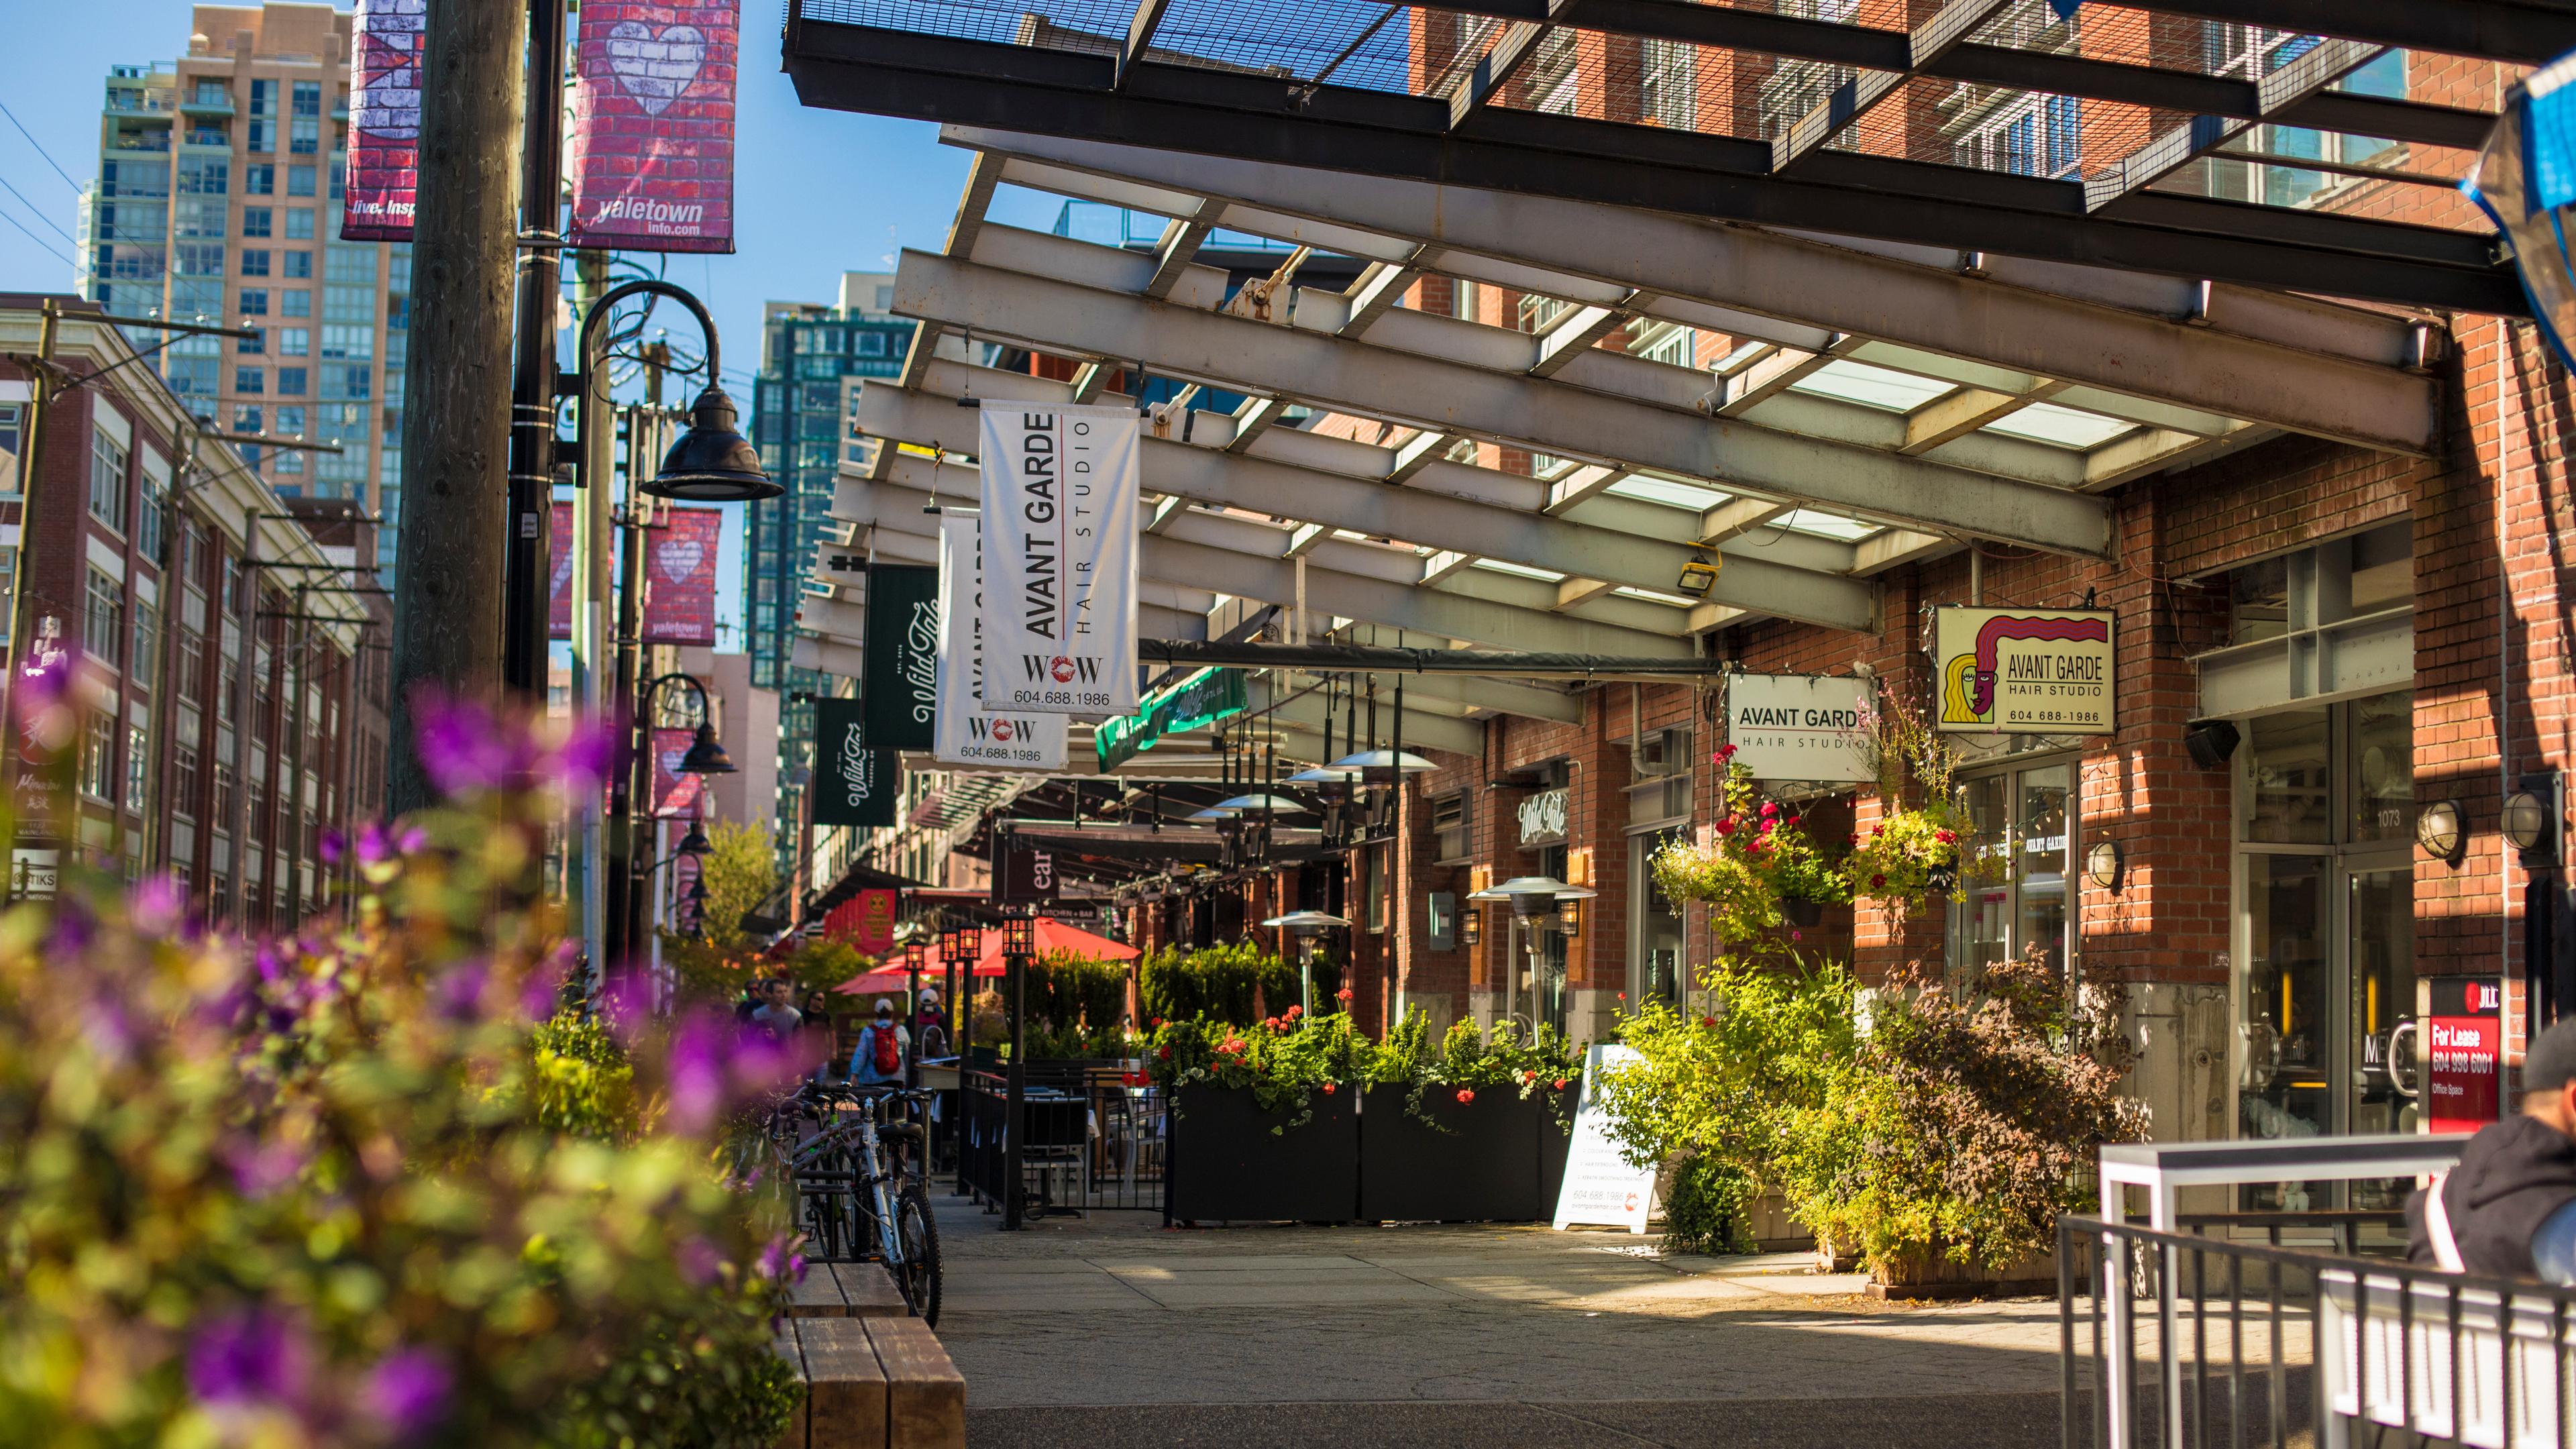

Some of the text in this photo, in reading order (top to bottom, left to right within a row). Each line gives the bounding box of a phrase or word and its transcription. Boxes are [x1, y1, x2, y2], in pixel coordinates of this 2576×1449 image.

[598, 197, 703, 223] yaletown
[648, 221, 700, 235] info.com
[1024, 413, 1055, 640] AVANT GARDE
[1075, 422, 1091, 634] HAIR STUDIO
[2008, 654, 2102, 680] AVANT GARDE
[906, 650, 937, 723] Wild
[1014, 690, 1110, 705] 604.688.1986
[2009, 685, 2101, 696] HAIR STUDIO
[1739, 708, 1868, 728] AVANT GARD
[2010, 710, 2098, 721] 604 688-1986
[961, 747, 1040, 761] 604.688.1986
[1743, 737, 1865, 749] HAIR STUDIO
[843, 757, 869, 807] Wild
[1518, 791, 1565, 844] Wild Tale
[2377, 809, 2400, 828] 1073
[2025, 837, 2045, 853] AVANT
[1034, 851, 1051, 890] ear
[2479, 985, 2499, 1008] JLL
[2432, 1024, 2480, 1047] For Lease
[2433, 1051, 2493, 1074] 604 998 6001
[2433, 1083, 2463, 1097] Office Space
